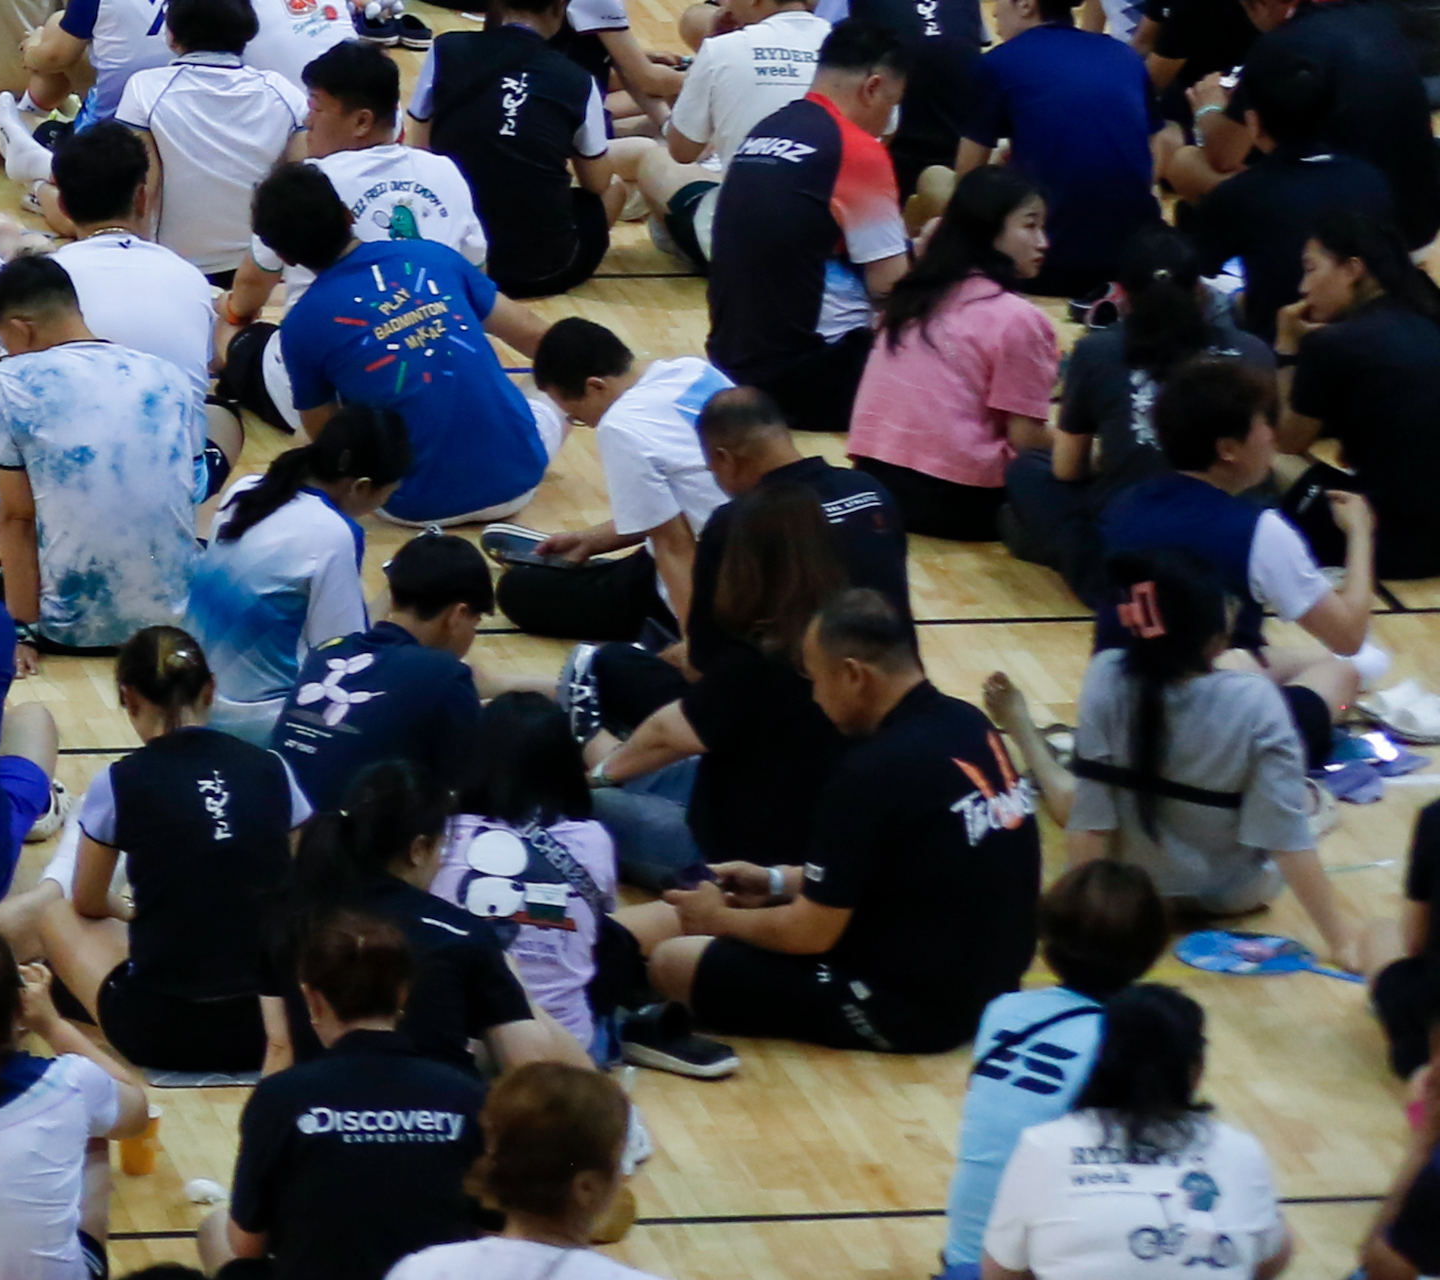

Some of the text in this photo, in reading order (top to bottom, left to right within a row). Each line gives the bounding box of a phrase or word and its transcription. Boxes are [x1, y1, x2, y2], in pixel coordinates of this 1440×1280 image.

[753, 63, 799, 77] week
[378, 287, 412, 316] PLAY
[372, 300, 449, 341] BADMINTON
[311, 1106, 464, 1140] Discovery
[343, 1133, 448, 1143] EXPEDITION
